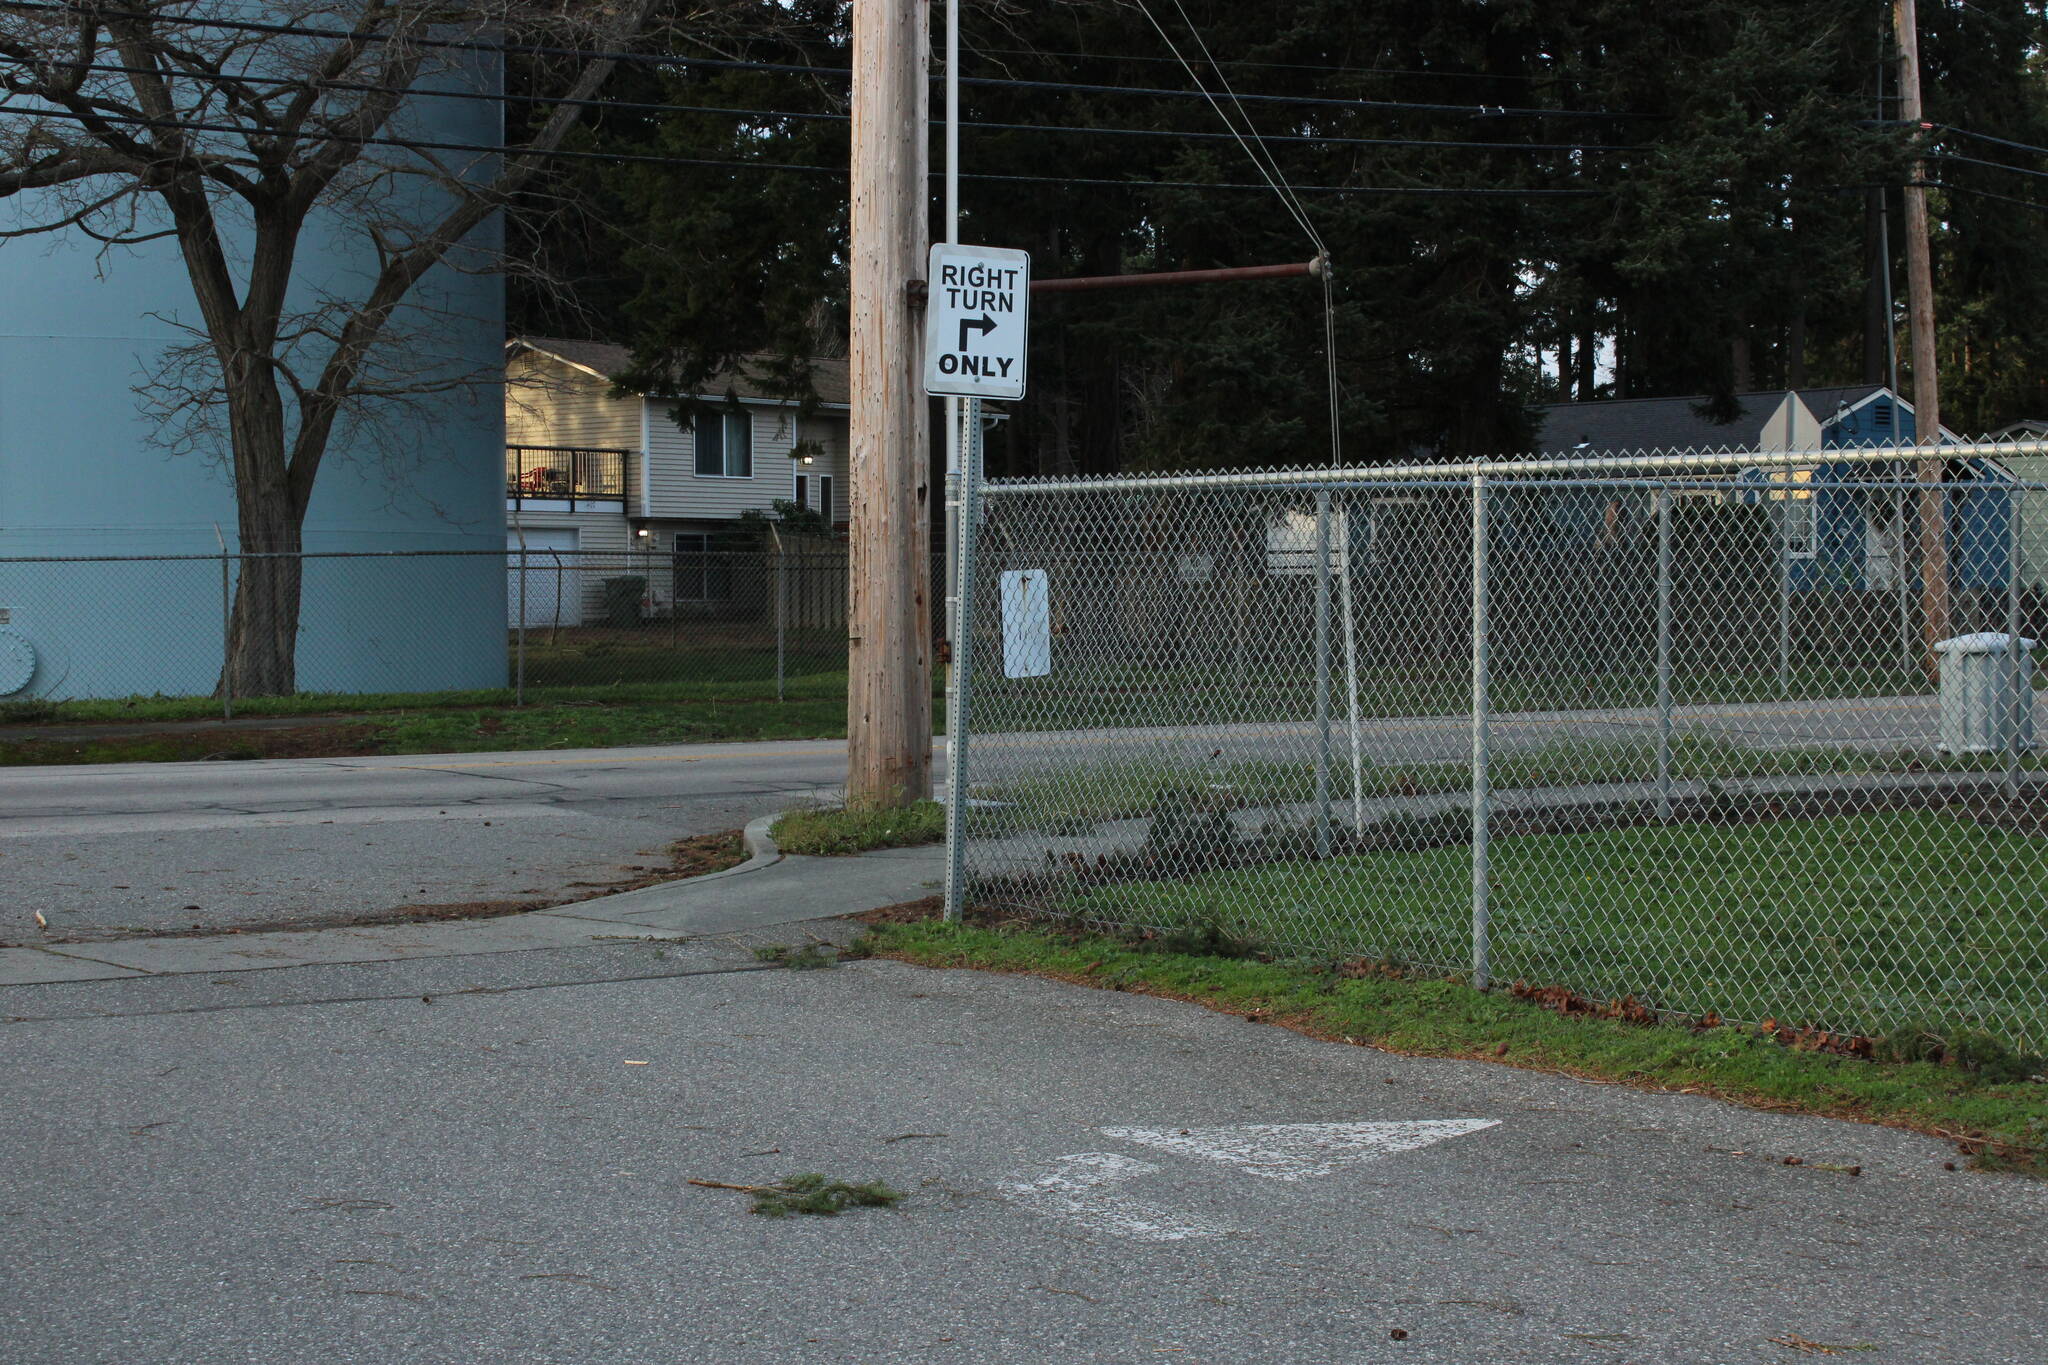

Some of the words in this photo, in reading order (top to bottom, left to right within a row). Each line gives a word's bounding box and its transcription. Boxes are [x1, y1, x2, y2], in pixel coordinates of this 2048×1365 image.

[942, 265, 1018, 290] RIGHT
[947, 288, 1013, 312] TURN
[939, 354, 1014, 378] ONLY
